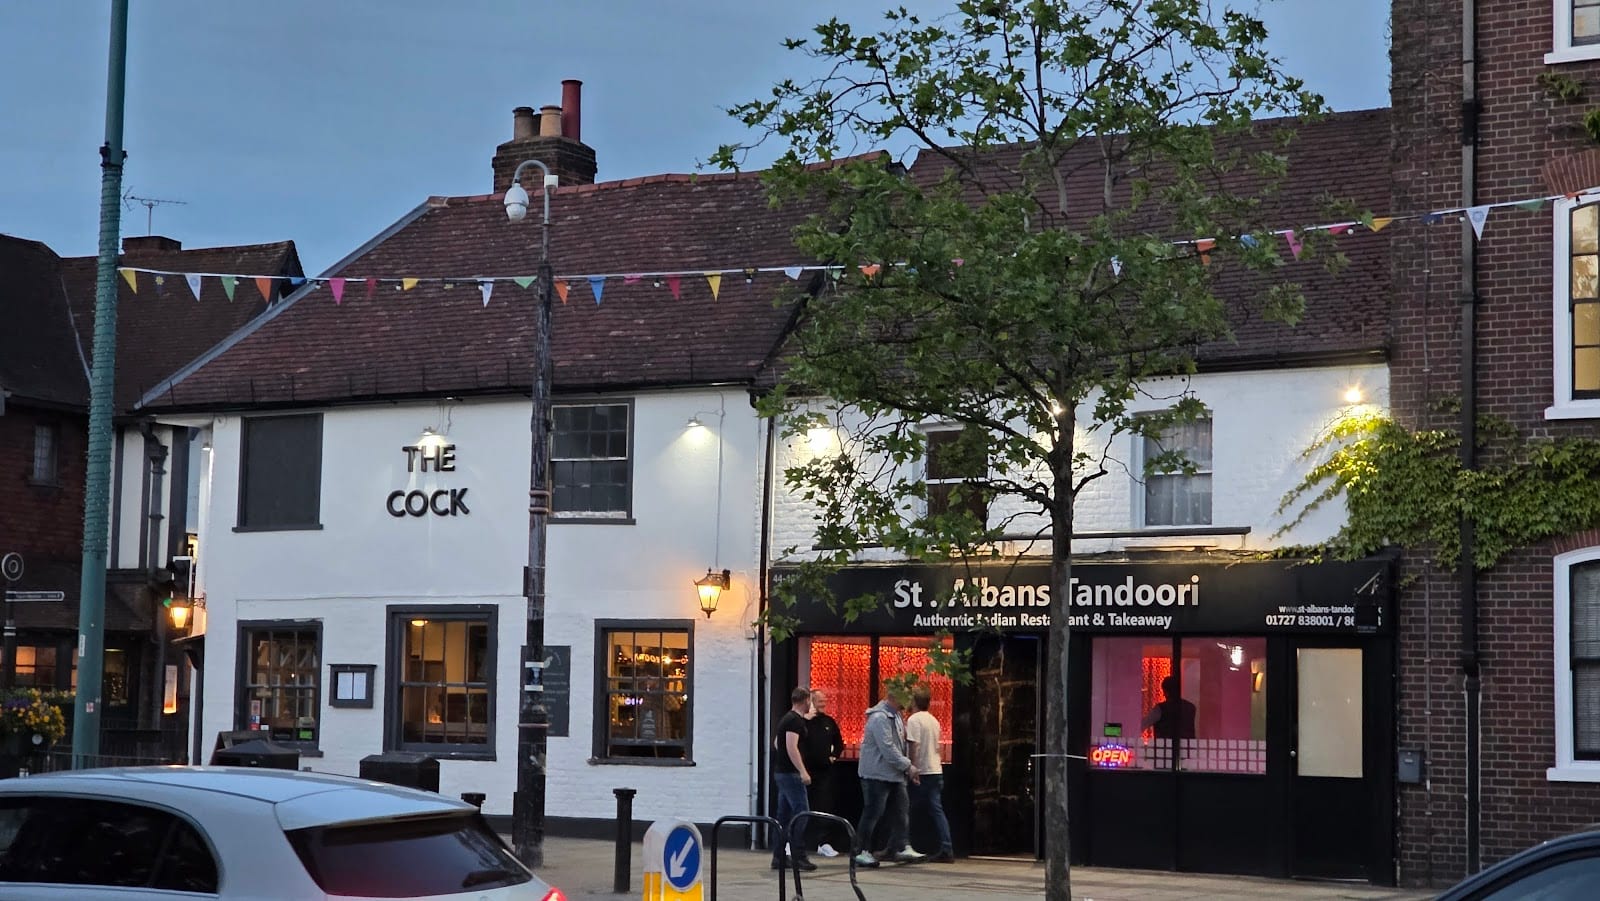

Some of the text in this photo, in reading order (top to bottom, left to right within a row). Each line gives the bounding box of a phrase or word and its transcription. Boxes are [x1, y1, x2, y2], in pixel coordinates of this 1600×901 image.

[402, 444, 456, 472] THE
[386, 488, 470, 517] COCK
[948, 577, 1050, 608] Albans
[913, 613, 975, 627] Authentic
[1092, 612, 1105, 627] &
[1108, 612, 1172, 630] Takeaway
[1265, 615, 1296, 626] 01727
[1298, 615, 1335, 626] 838001
[1092, 749, 1130, 763] OPEN
